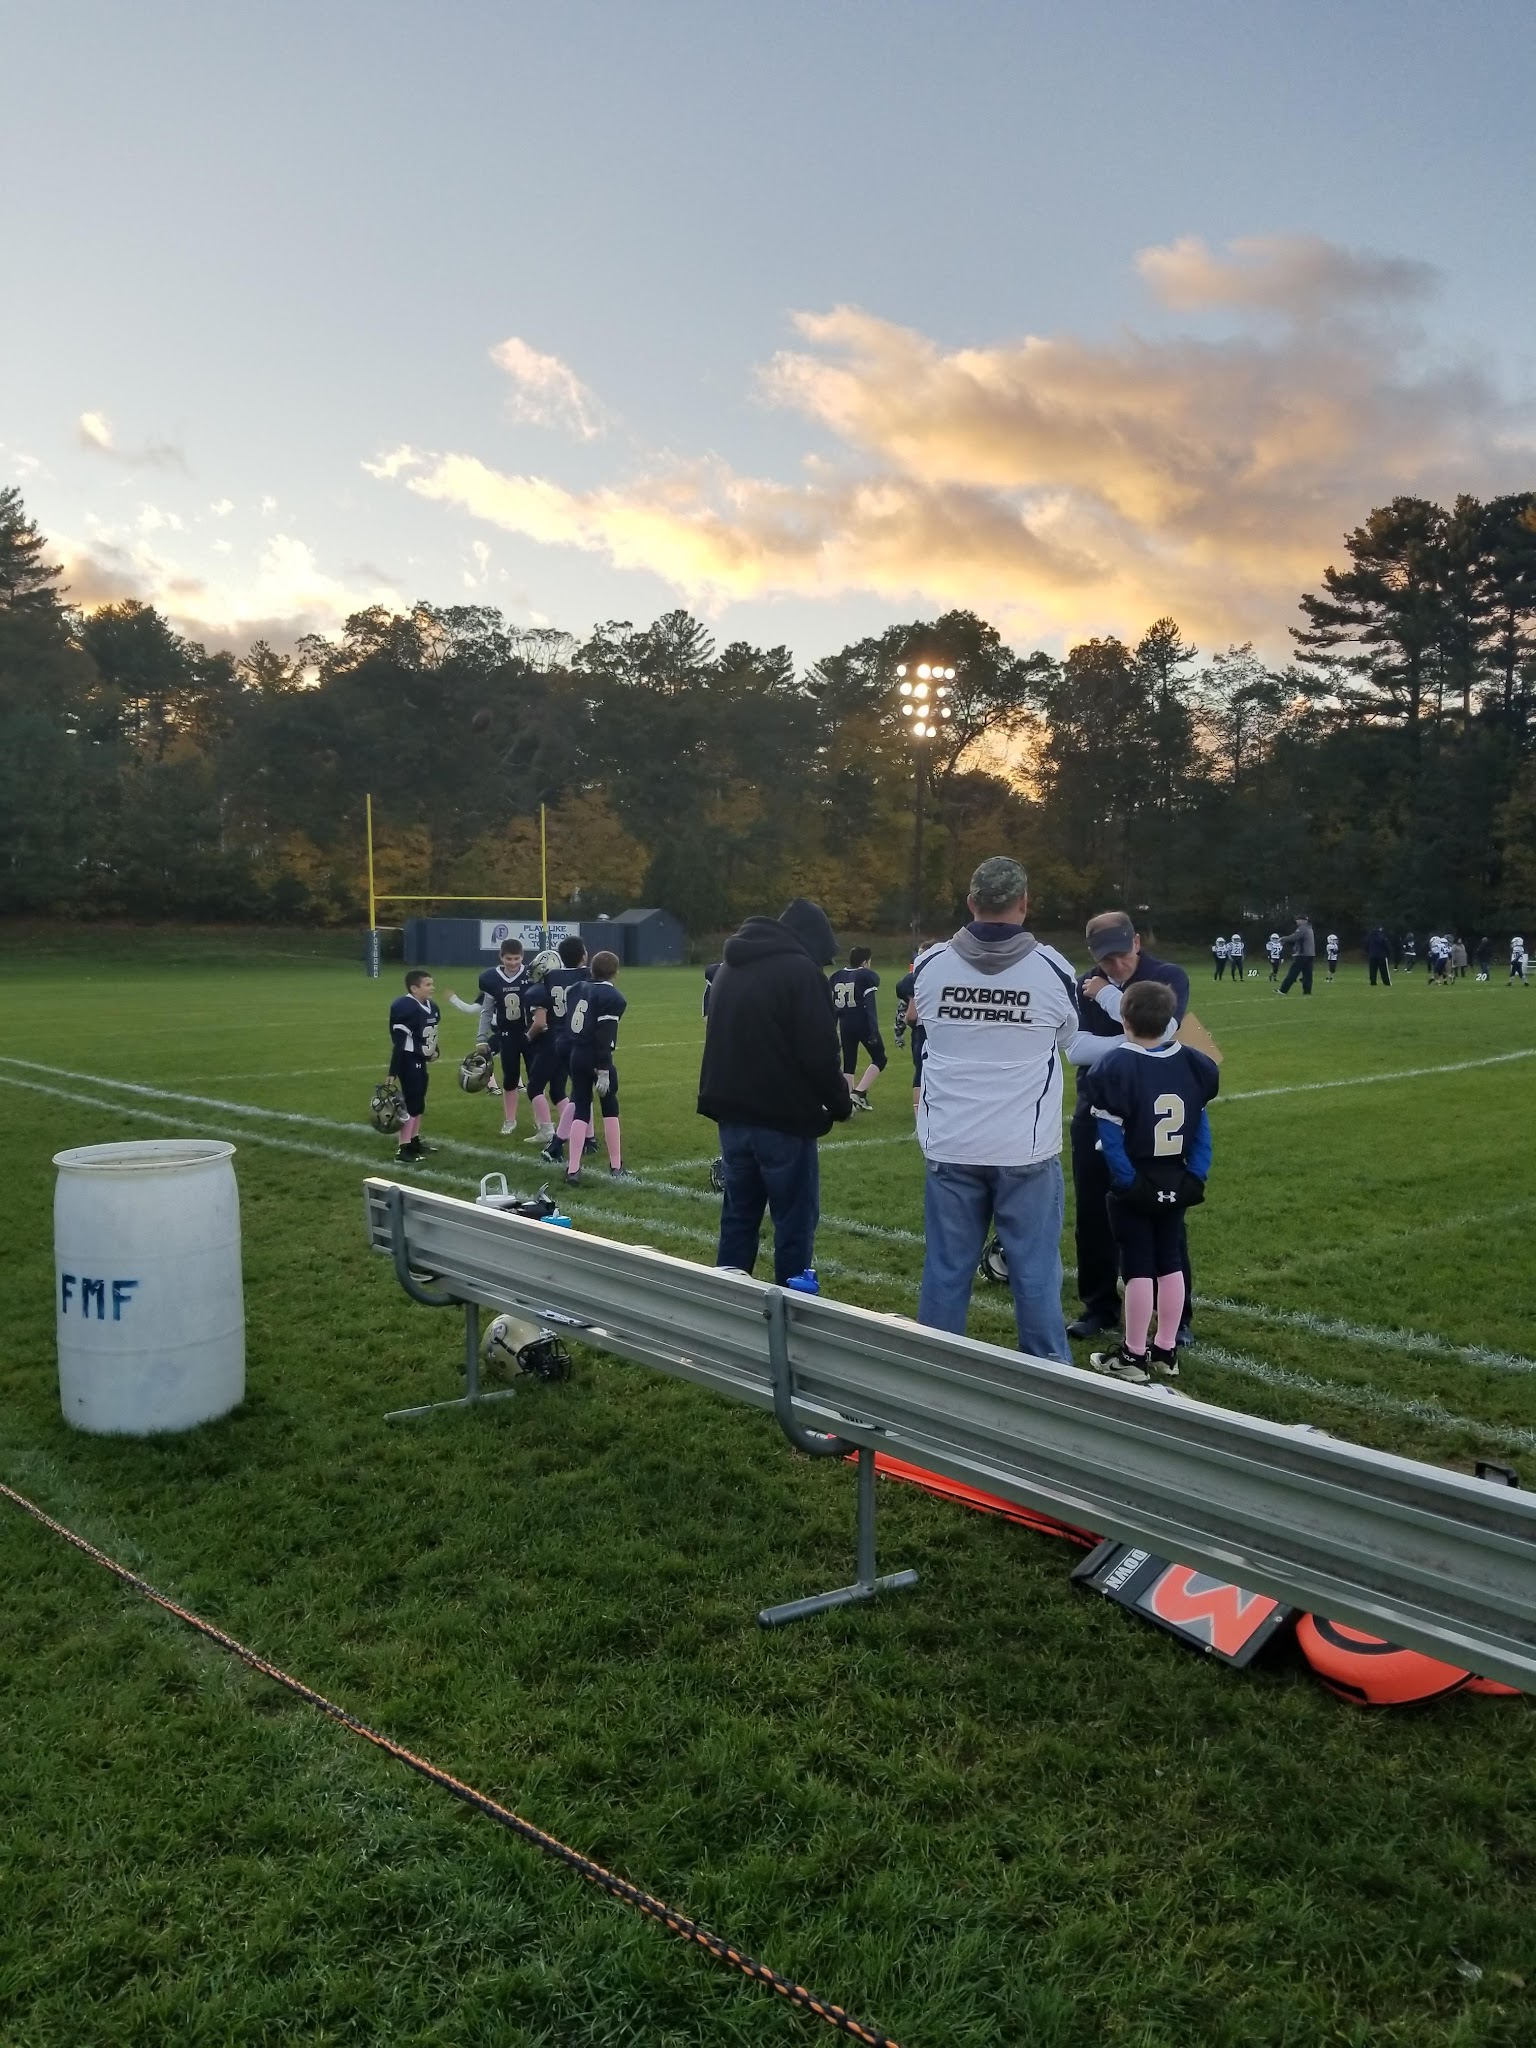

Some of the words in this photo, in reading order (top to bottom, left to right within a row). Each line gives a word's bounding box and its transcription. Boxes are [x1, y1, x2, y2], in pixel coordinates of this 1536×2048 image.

[1475, 973, 1488, 981] 20
[504, 993, 521, 1021] 8
[834, 982, 857, 1009] 37
[941, 986, 1030, 1007] FOXBORO
[570, 999, 589, 1034] 6
[937, 1006, 1033, 1023] FOOTBALL
[1153, 1093, 1185, 1157] 2
[62, 1272, 139, 1321] FMF
[1105, 1548, 1150, 1590] DOWN
